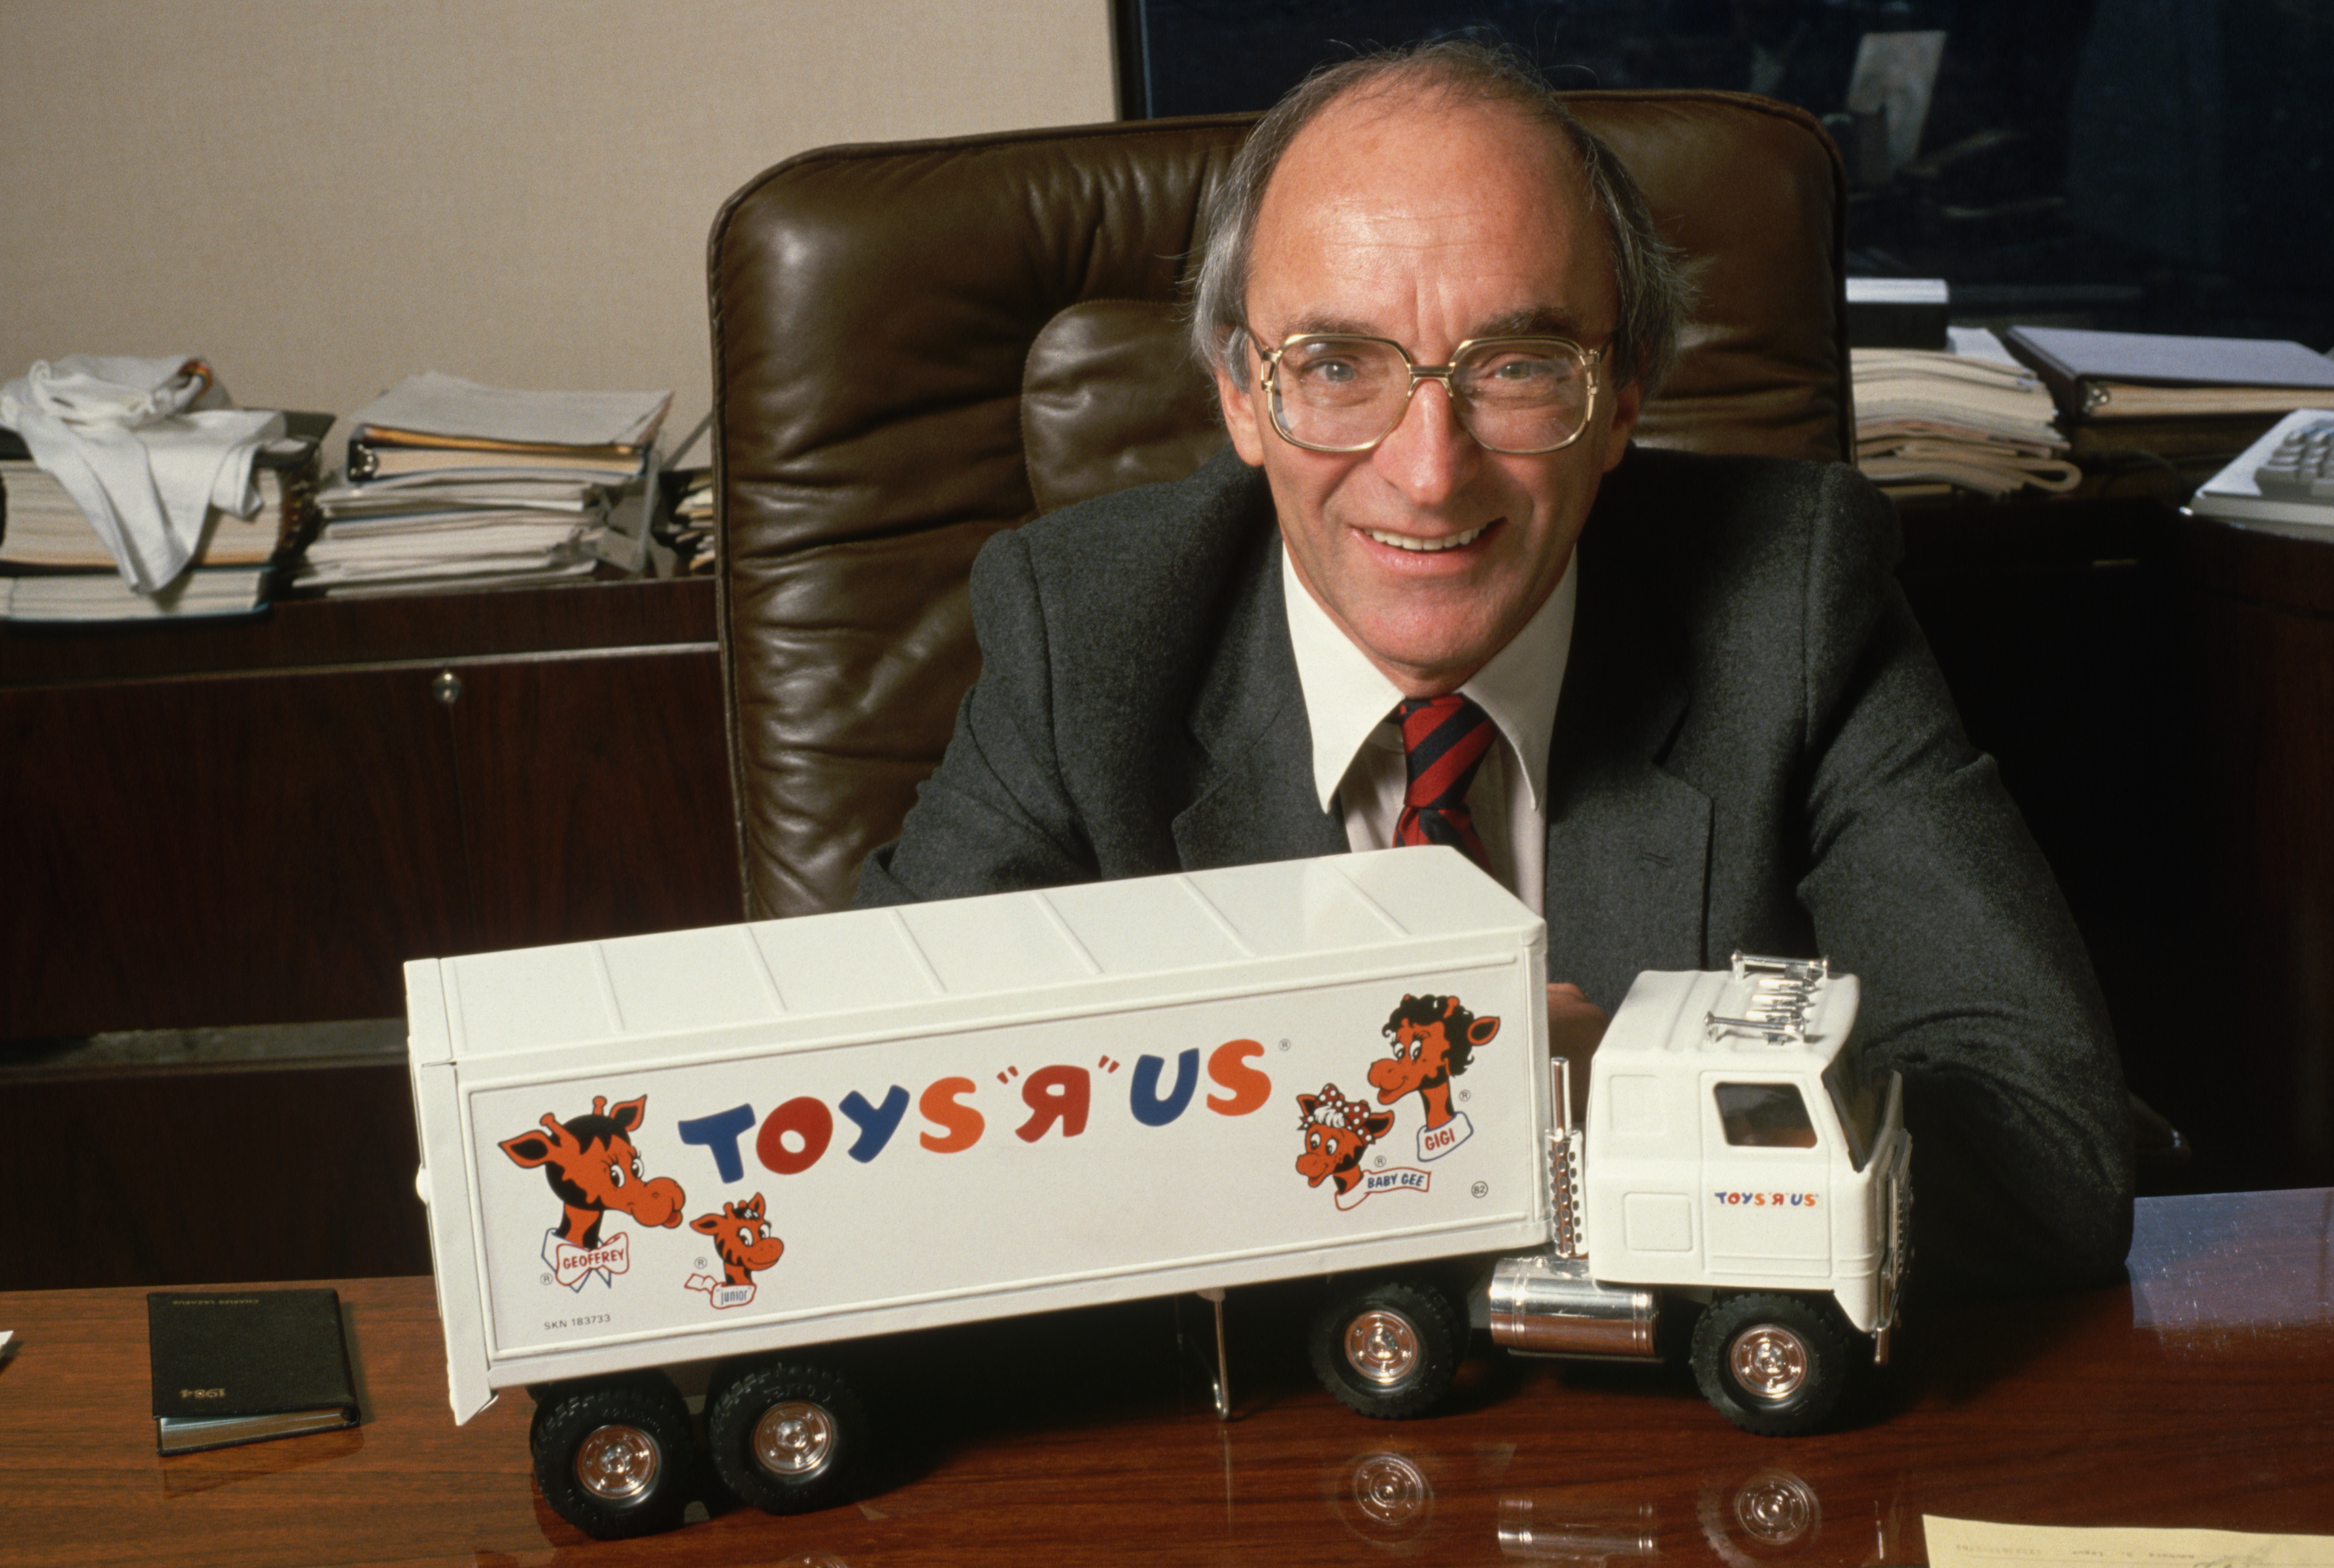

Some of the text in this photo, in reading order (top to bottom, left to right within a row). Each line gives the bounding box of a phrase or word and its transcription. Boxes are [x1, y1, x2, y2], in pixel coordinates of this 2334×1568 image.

[678, 1076, 985, 1184] TOYS
[1424, 1128, 1456, 1151] GIGI
[1367, 1172, 1425, 1189] BABY GEE
[1473, 1185, 1485, 1194] 82
[1714, 1191, 1766, 1206] TOYS
[562, 1248, 624, 1269] GEOFFREY
[544, 1314, 611, 1330] SKN 183733
[179, 1388, 226, 1398] 1984
